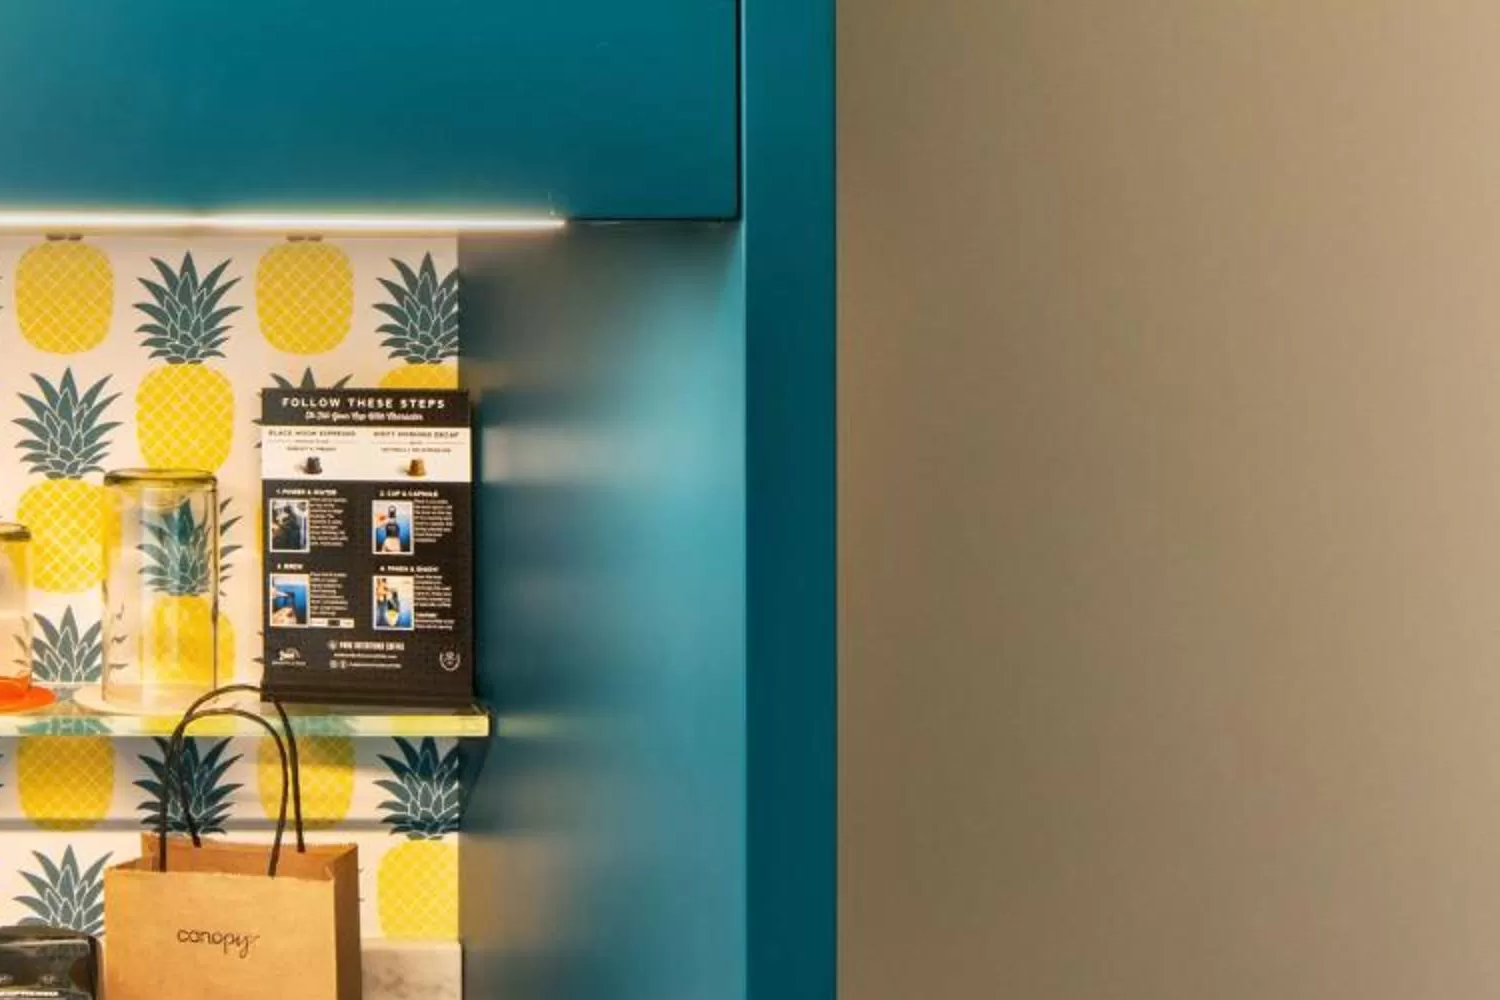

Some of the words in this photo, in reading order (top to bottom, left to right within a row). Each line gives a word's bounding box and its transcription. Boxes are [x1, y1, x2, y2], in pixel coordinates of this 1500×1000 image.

[281, 397, 341, 408] FOLLOW
[348, 397, 394, 409] THESE
[400, 398, 446, 409] STEPS
[177, 929, 250, 959] canopy
